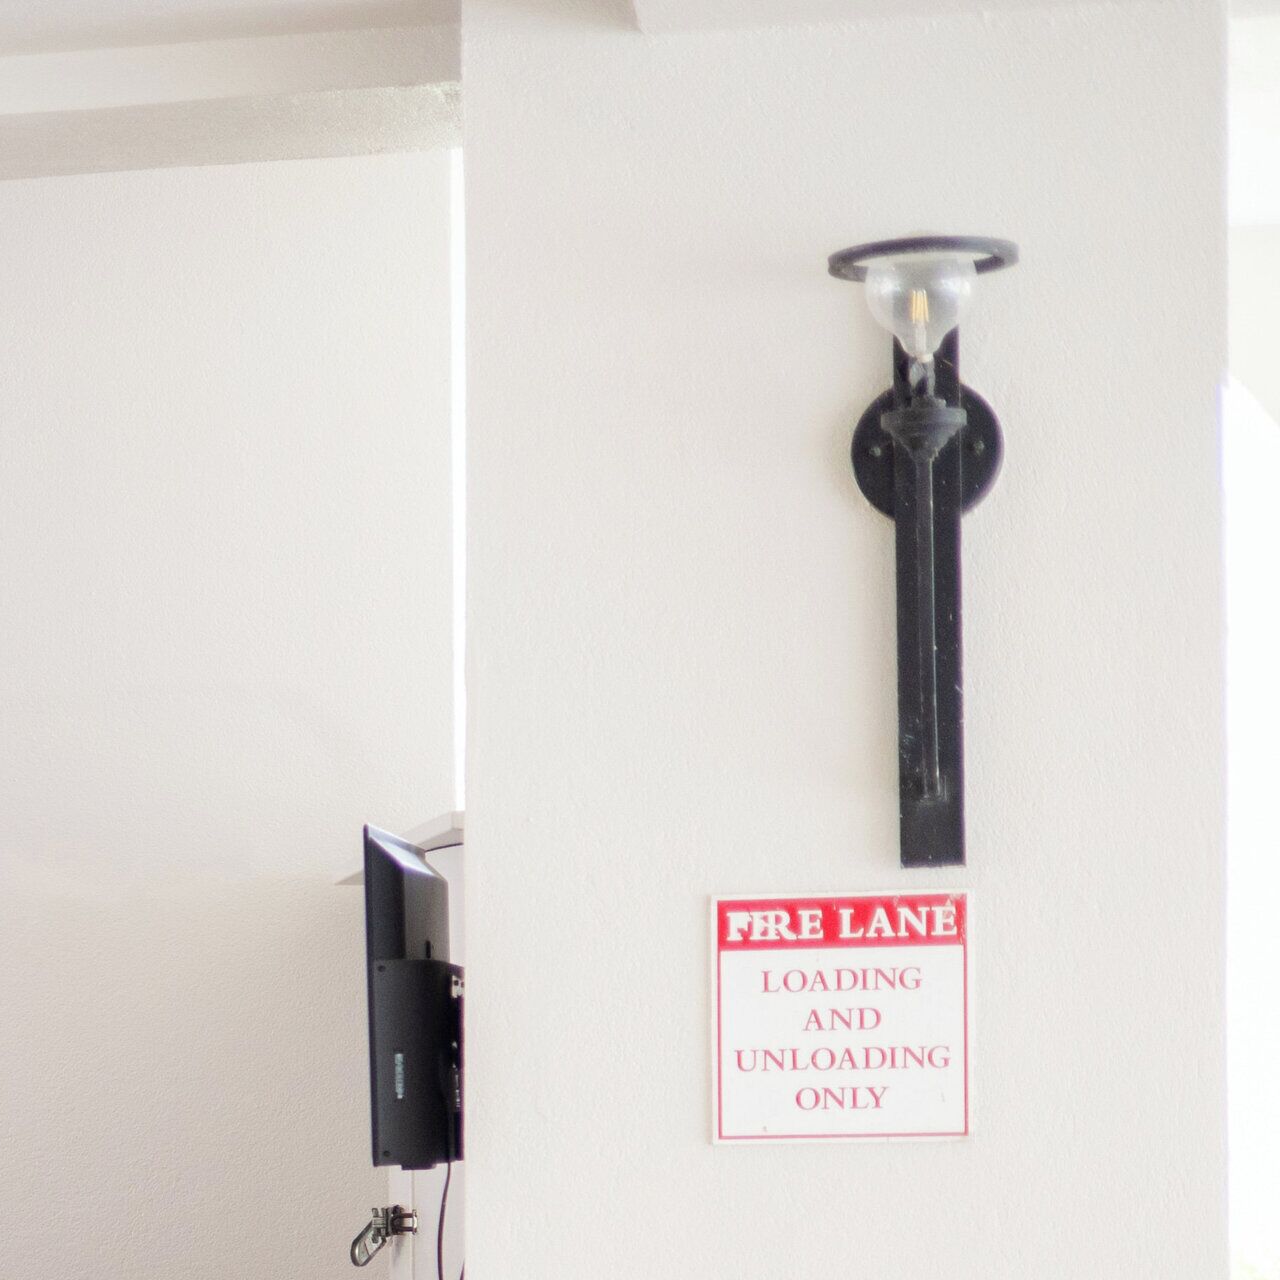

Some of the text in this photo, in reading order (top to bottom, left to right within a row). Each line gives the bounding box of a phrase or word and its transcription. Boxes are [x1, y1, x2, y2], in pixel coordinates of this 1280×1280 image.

[838, 905, 956, 939] LANE
[762, 967, 921, 993] LOADING
[804, 1007, 882, 1031] AND
[734, 1046, 950, 1072] UNLOADING
[795, 1086, 887, 1110] ONLY
